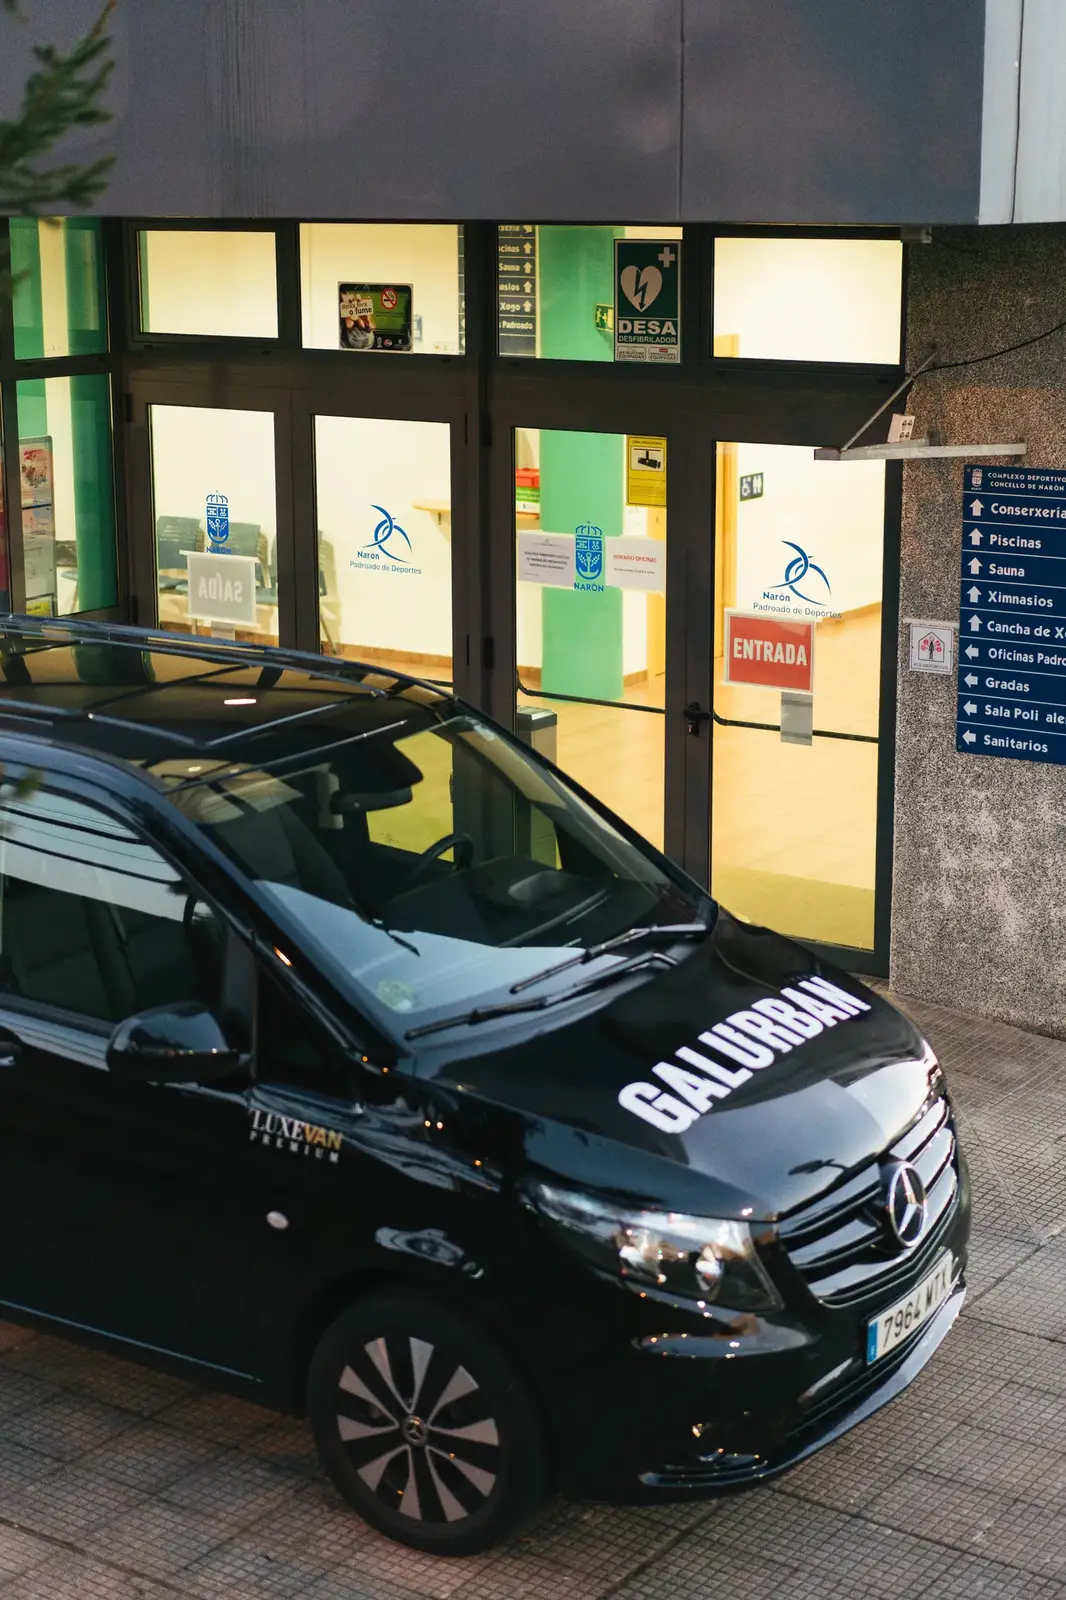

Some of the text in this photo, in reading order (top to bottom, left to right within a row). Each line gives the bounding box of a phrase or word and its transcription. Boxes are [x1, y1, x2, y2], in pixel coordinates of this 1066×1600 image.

[355, 307, 373, 315] fume
[500, 302, 521, 312] Xogo
[618, 319, 677, 336] DESA
[618, 336, 677, 344] DESFIBRILADOR
[987, 472, 1066, 483] COMPLEXO DEPORTIVO
[990, 481, 1025, 489] CONCELLO
[1038, 483, 1064, 491] NARÓN
[991, 503, 1066, 519] Conserxería
[989, 534, 1042, 549] Piscinas
[357, 551, 380, 560] Narón
[349, 560, 381, 571] Padroado
[391, 565, 422, 575] Deportes
[989, 563, 1025, 577] Sauna
[574, 582, 604, 592] NARÓN
[763, 591, 791, 602] Narón
[988, 591, 1054, 608] Ximnasios
[753, 603, 791, 614] Padroado
[804, 608, 842, 619] Deportes
[987, 621, 1030, 635] Cancha
[1034, 626, 1051, 637] de
[733, 637, 808, 667] ENTRADA
[988, 648, 1034, 663] Oficinas
[913, 662, 949, 670] POLIDEPORTIVO
[985, 677, 1030, 693] Gradas
[984, 704, 1011, 718] Sala
[1014, 708, 1039, 721] Poli
[983, 734, 1049, 753] Sanitarios
[618, 976, 871, 1134] GALURBAN
[249, 1130, 339, 1164] PREMIUM
[883, 1293, 921, 1348] 7964
